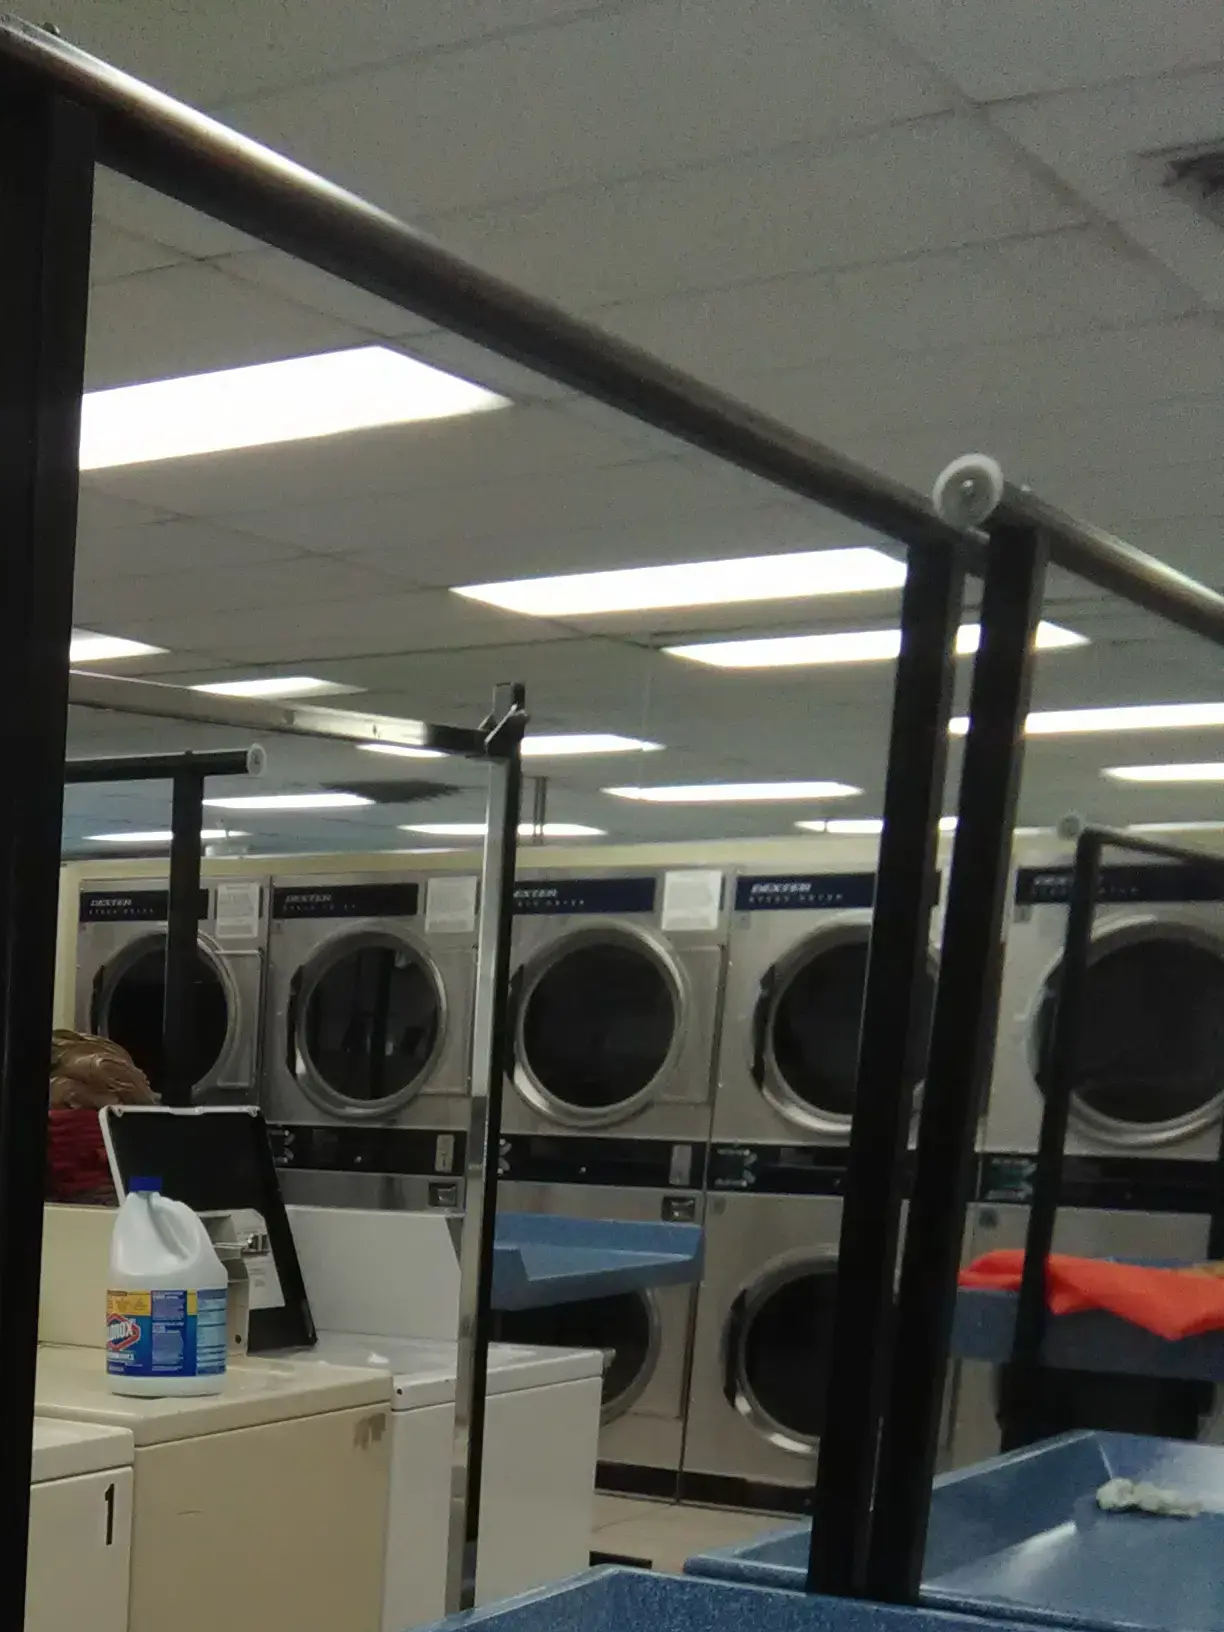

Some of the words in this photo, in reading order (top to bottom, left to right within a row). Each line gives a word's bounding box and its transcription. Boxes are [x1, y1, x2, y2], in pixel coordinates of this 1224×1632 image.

[750, 883, 812, 893] DEXTER
[513, 889, 558, 898] EXTER
[90, 899, 132, 907] DEXTER
[105, 1483, 114, 1545] 1
